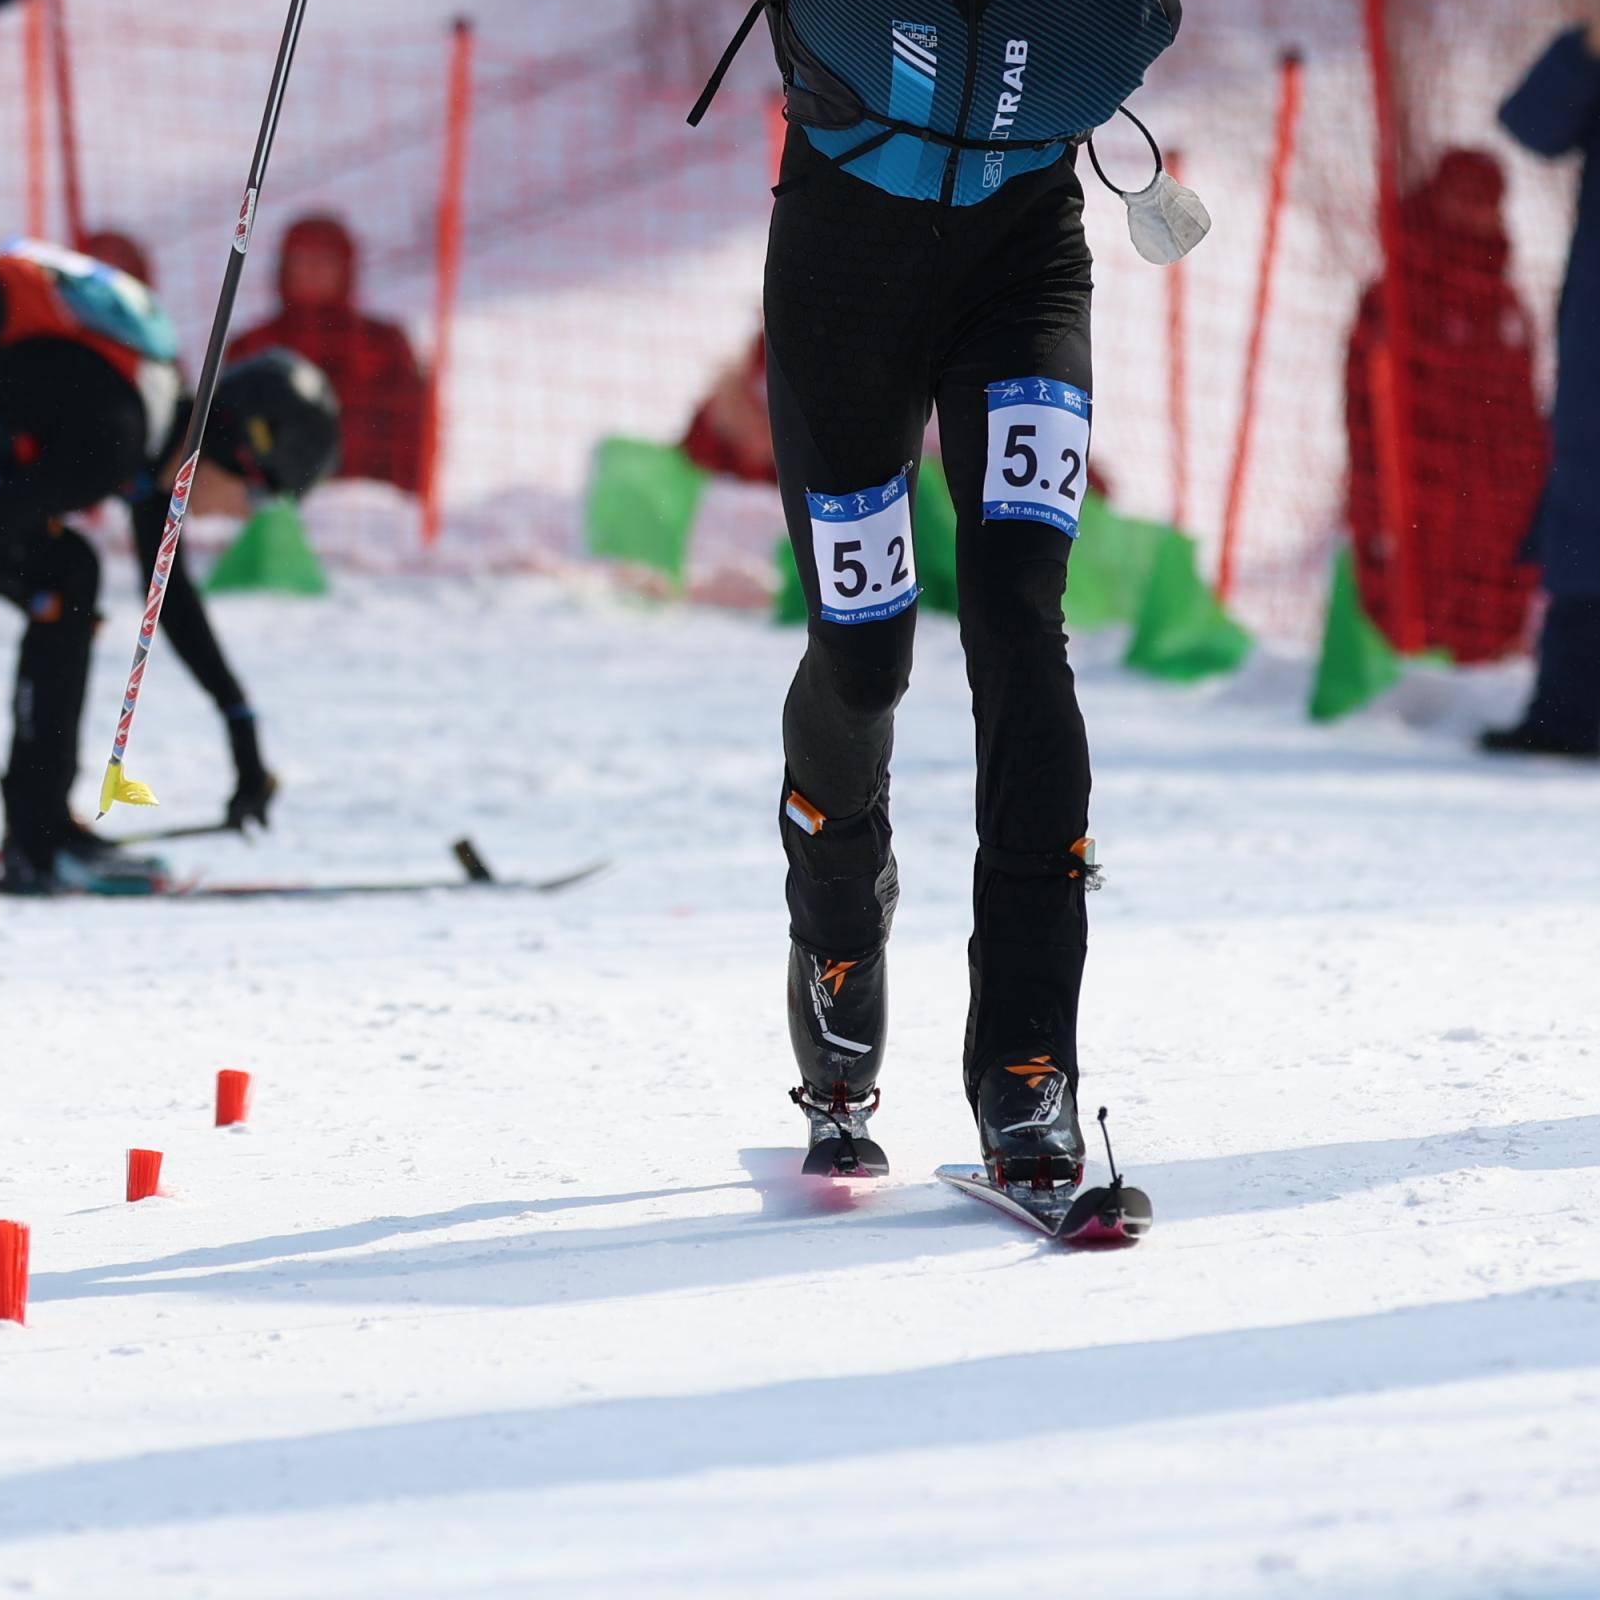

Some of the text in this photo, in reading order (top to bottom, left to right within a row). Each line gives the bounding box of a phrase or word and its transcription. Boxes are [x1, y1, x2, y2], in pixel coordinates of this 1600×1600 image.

[1002, 424, 1081, 501] 5.2
[833, 535, 909, 599] 5.2
[1031, 1078, 1060, 1122] RACE
